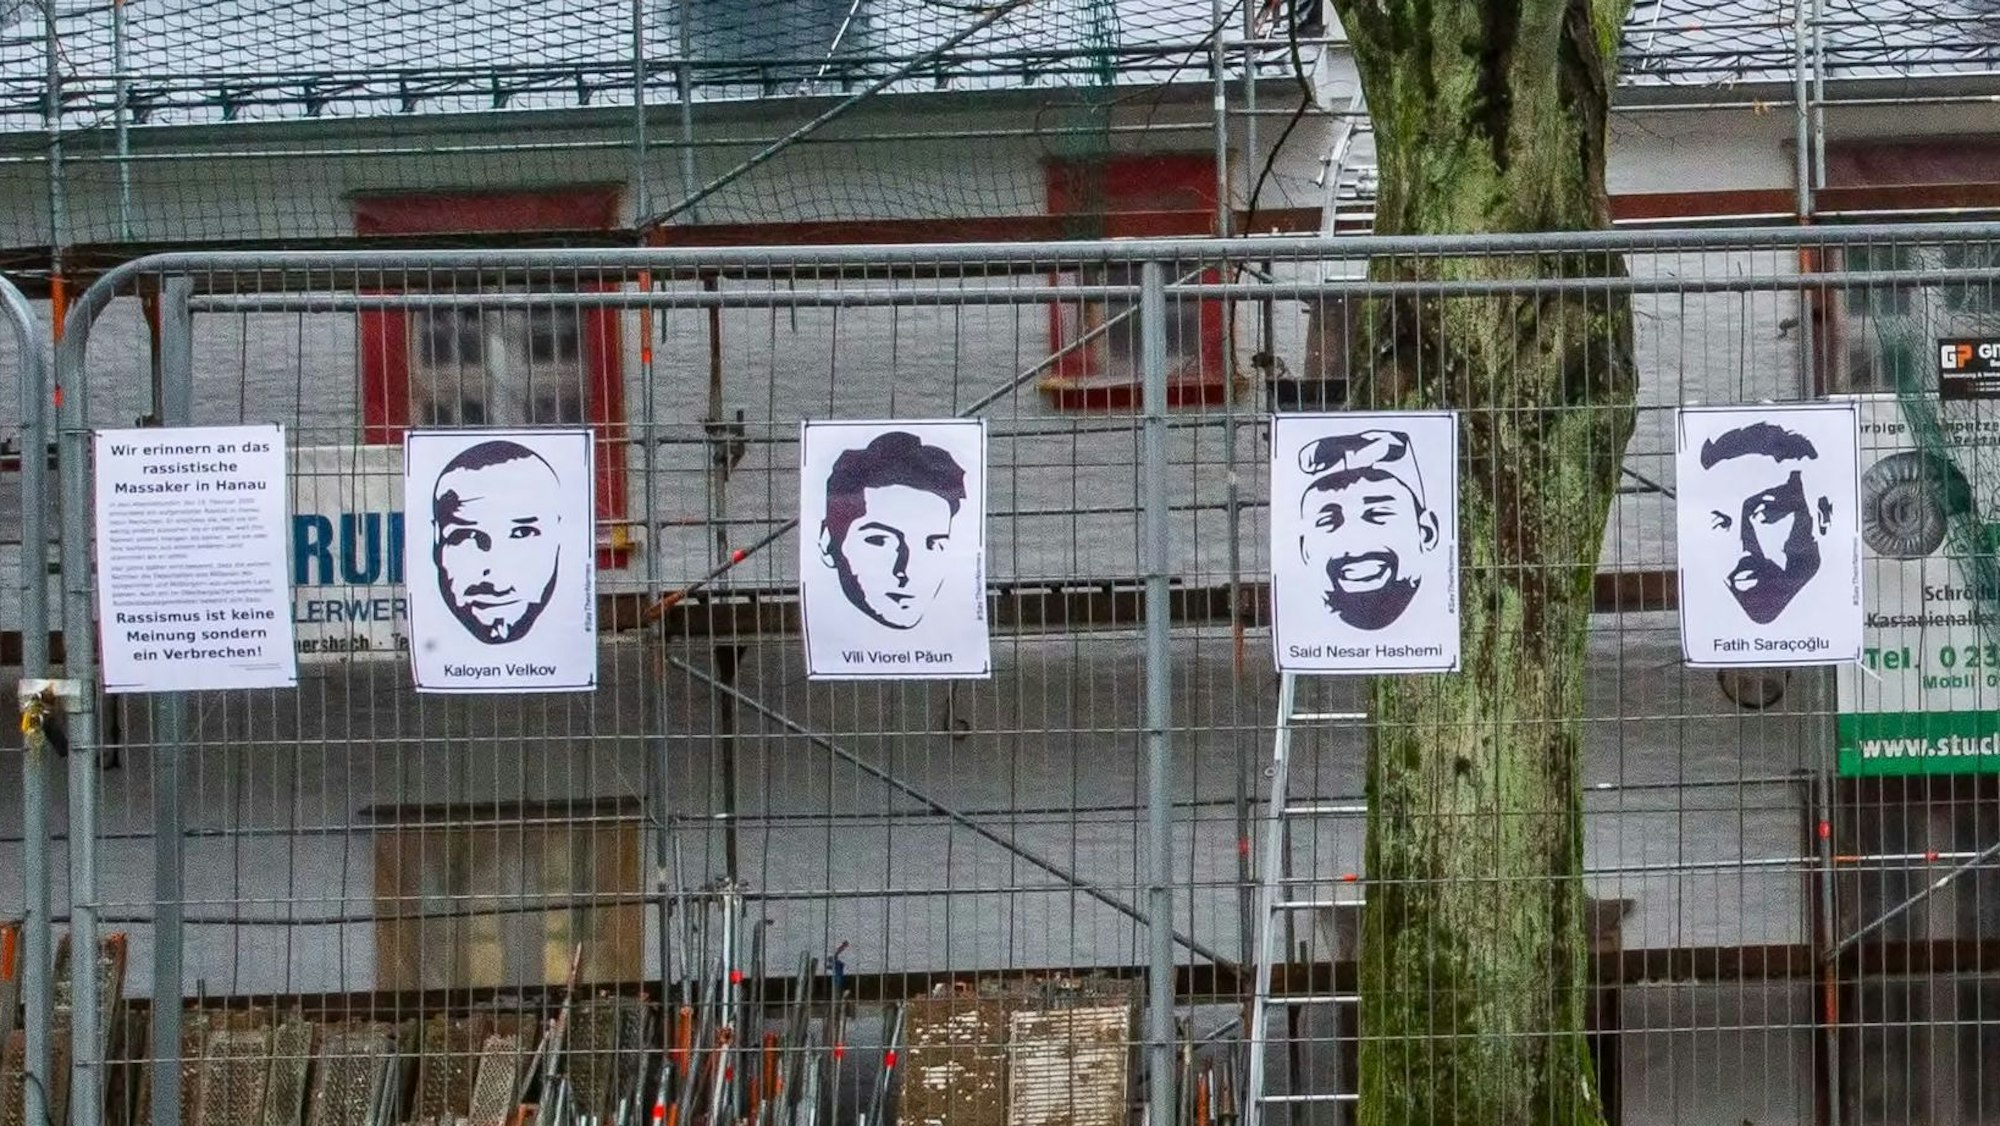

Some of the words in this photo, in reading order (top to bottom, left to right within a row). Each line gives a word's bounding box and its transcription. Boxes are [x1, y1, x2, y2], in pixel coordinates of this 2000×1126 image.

[1860, 422, 1905, 435] rbige
[111, 445, 138, 456] Wir
[143, 443, 211, 456] erinnern
[217, 444, 236, 454] an
[242, 441, 270, 453] das
[143, 461, 238, 475] rassistische
[114, 481, 190, 494] Massaker
[196, 480, 210, 491] in
[216, 479, 267, 491] Hanau
[116, 610, 200, 623] Rassismus
[206, 609, 227, 621] ist
[232, 608, 275, 620] keine
[127, 630, 196, 643] Meinung
[202, 628, 267, 640] sondern
[1289, 645, 1322, 658] Said
[1326, 645, 1371, 658] Nesar
[1375, 643, 1443, 657] Hashemi
[1713, 638, 1750, 651] Fatih
[1753, 637, 1830, 653] Saraçoğlu
[133, 649, 158, 661] ein
[163, 645, 262, 660] Verbrechen!
[868, 650, 911, 664] Viorel
[915, 649, 953, 663] Păun
[444, 664, 501, 679] Kaloyan
[505, 663, 557, 677] Velkov
